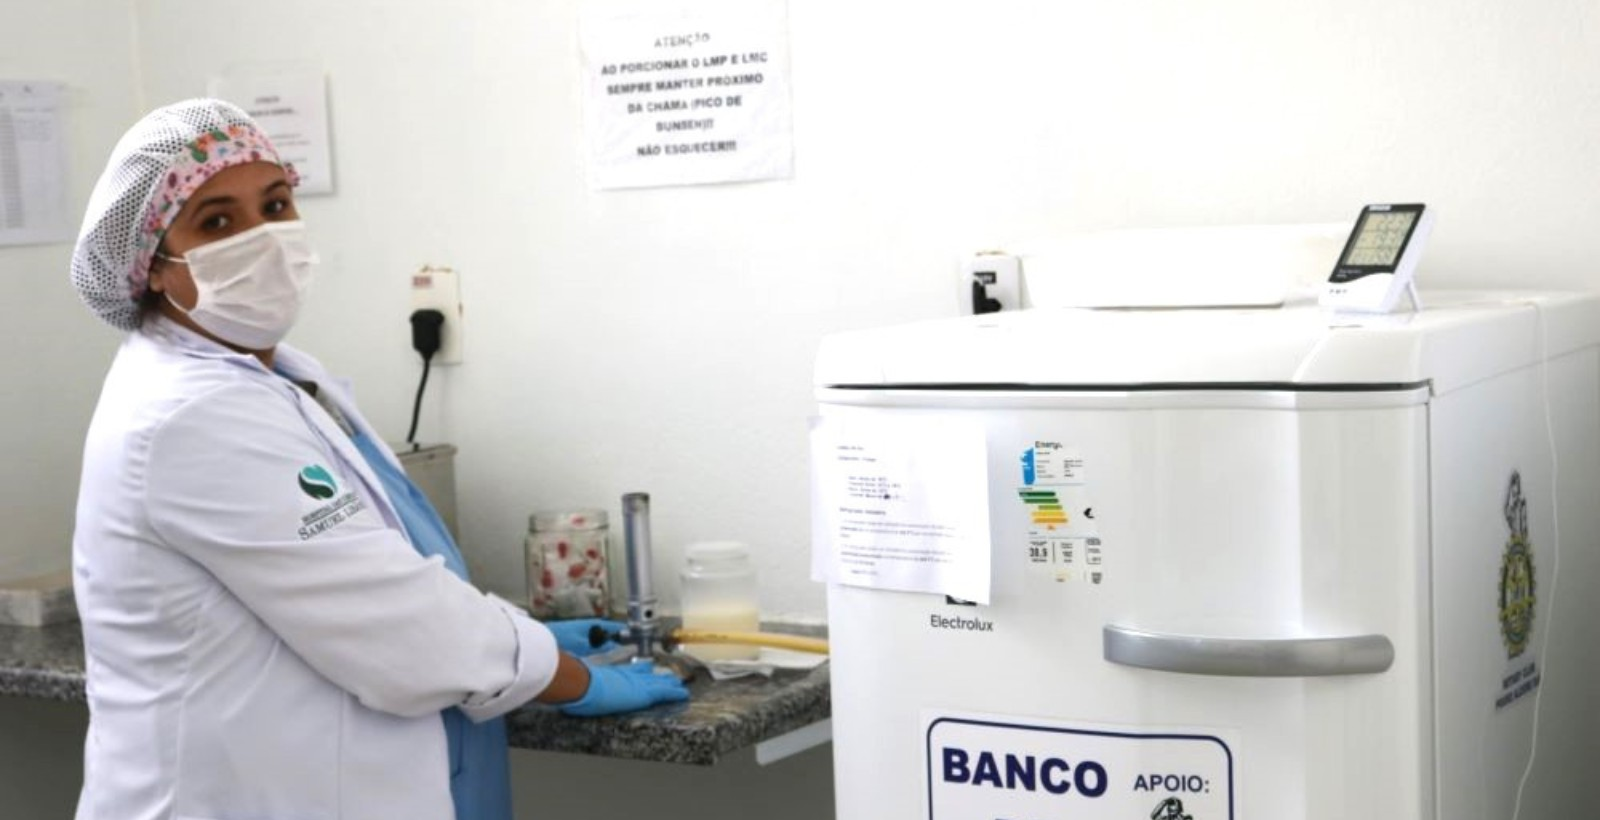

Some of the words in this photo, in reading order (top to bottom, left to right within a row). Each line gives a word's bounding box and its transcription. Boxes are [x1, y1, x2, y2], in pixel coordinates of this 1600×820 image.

[601, 64, 617, 76] AO
[620, 58, 688, 74] PORCIONAR
[703, 54, 728, 68] LMP
[731, 53, 739, 65] E
[607, 82, 653, 96] SEMPRE
[656, 76, 704, 91] MANTER
[647, 99, 688, 113] CHAMA
[726, 95, 743, 107] DE
[637, 143, 662, 156] NÃO
[930, 613, 994, 631] Electrolux
[942, 747, 1108, 798] BANCO
[1133, 773, 1210, 794] APOIO:
